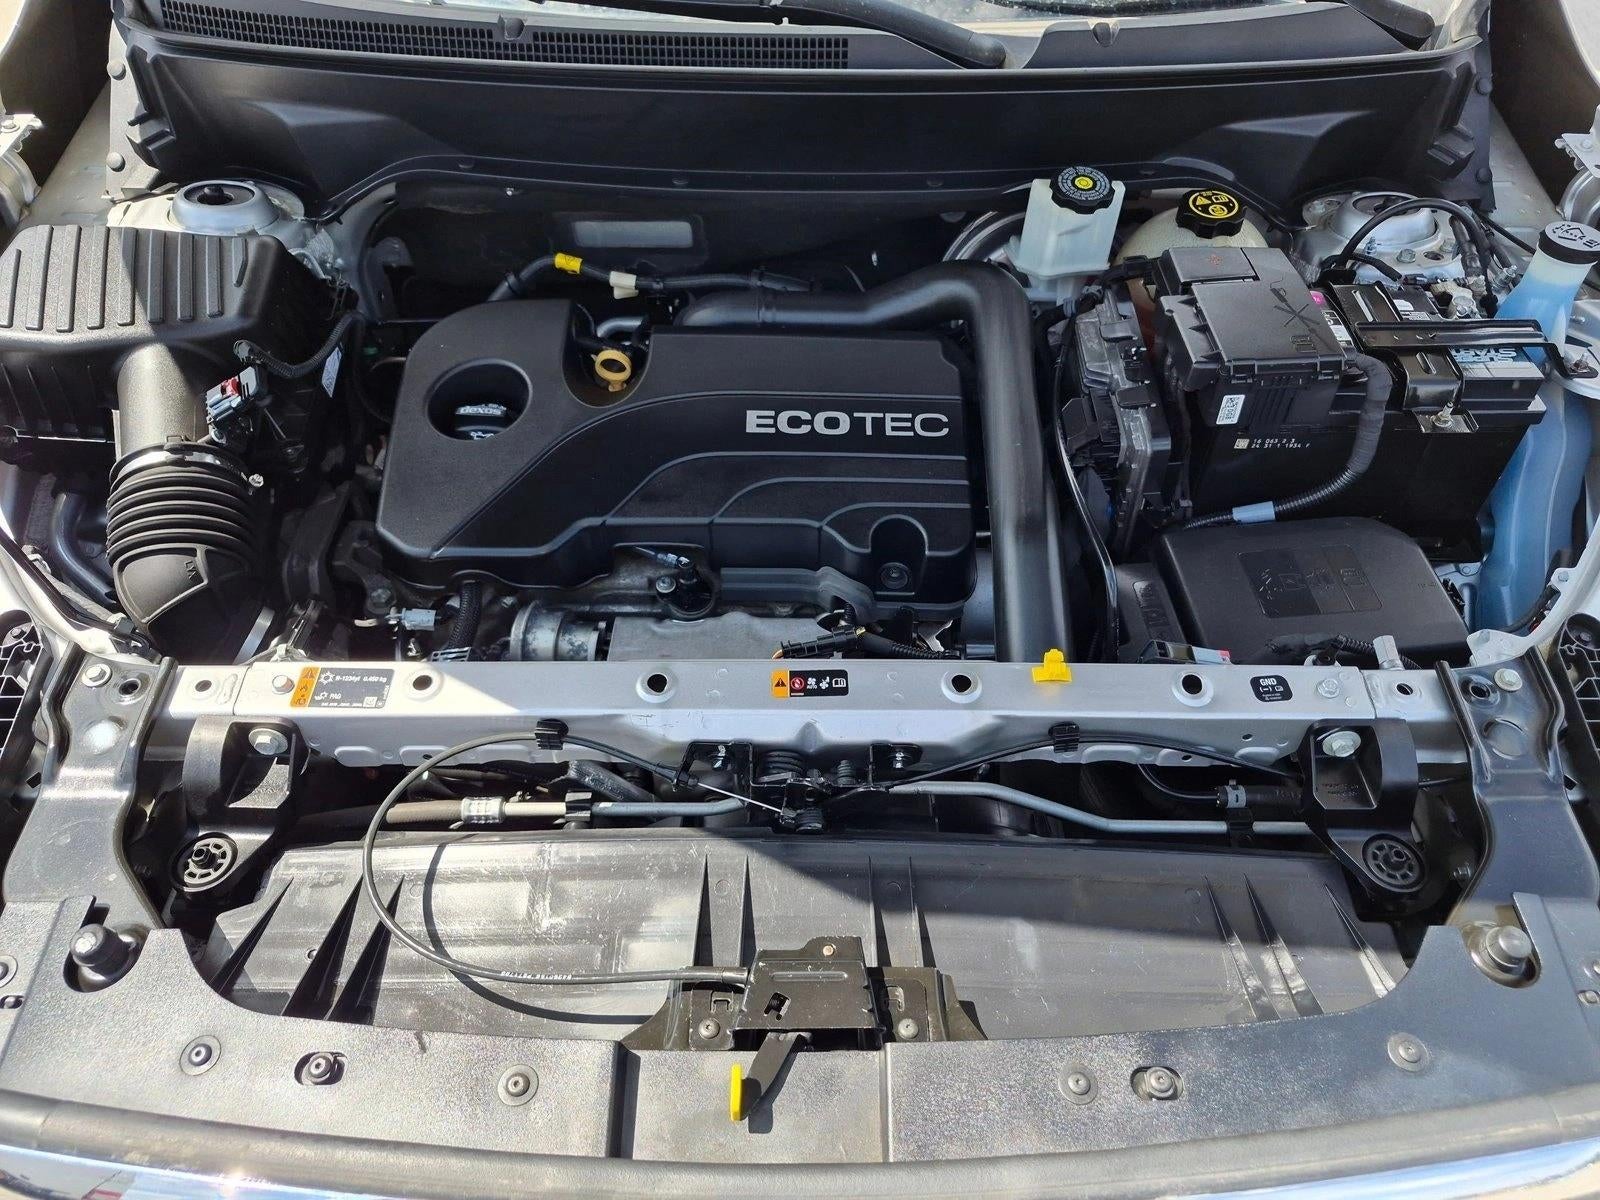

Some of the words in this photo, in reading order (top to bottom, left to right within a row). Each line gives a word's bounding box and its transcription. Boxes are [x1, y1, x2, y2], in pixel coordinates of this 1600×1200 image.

[460, 405, 501, 415] dexos
[745, 409, 949, 437] ECOTEC
[1259, 678, 1277, 686] GND
